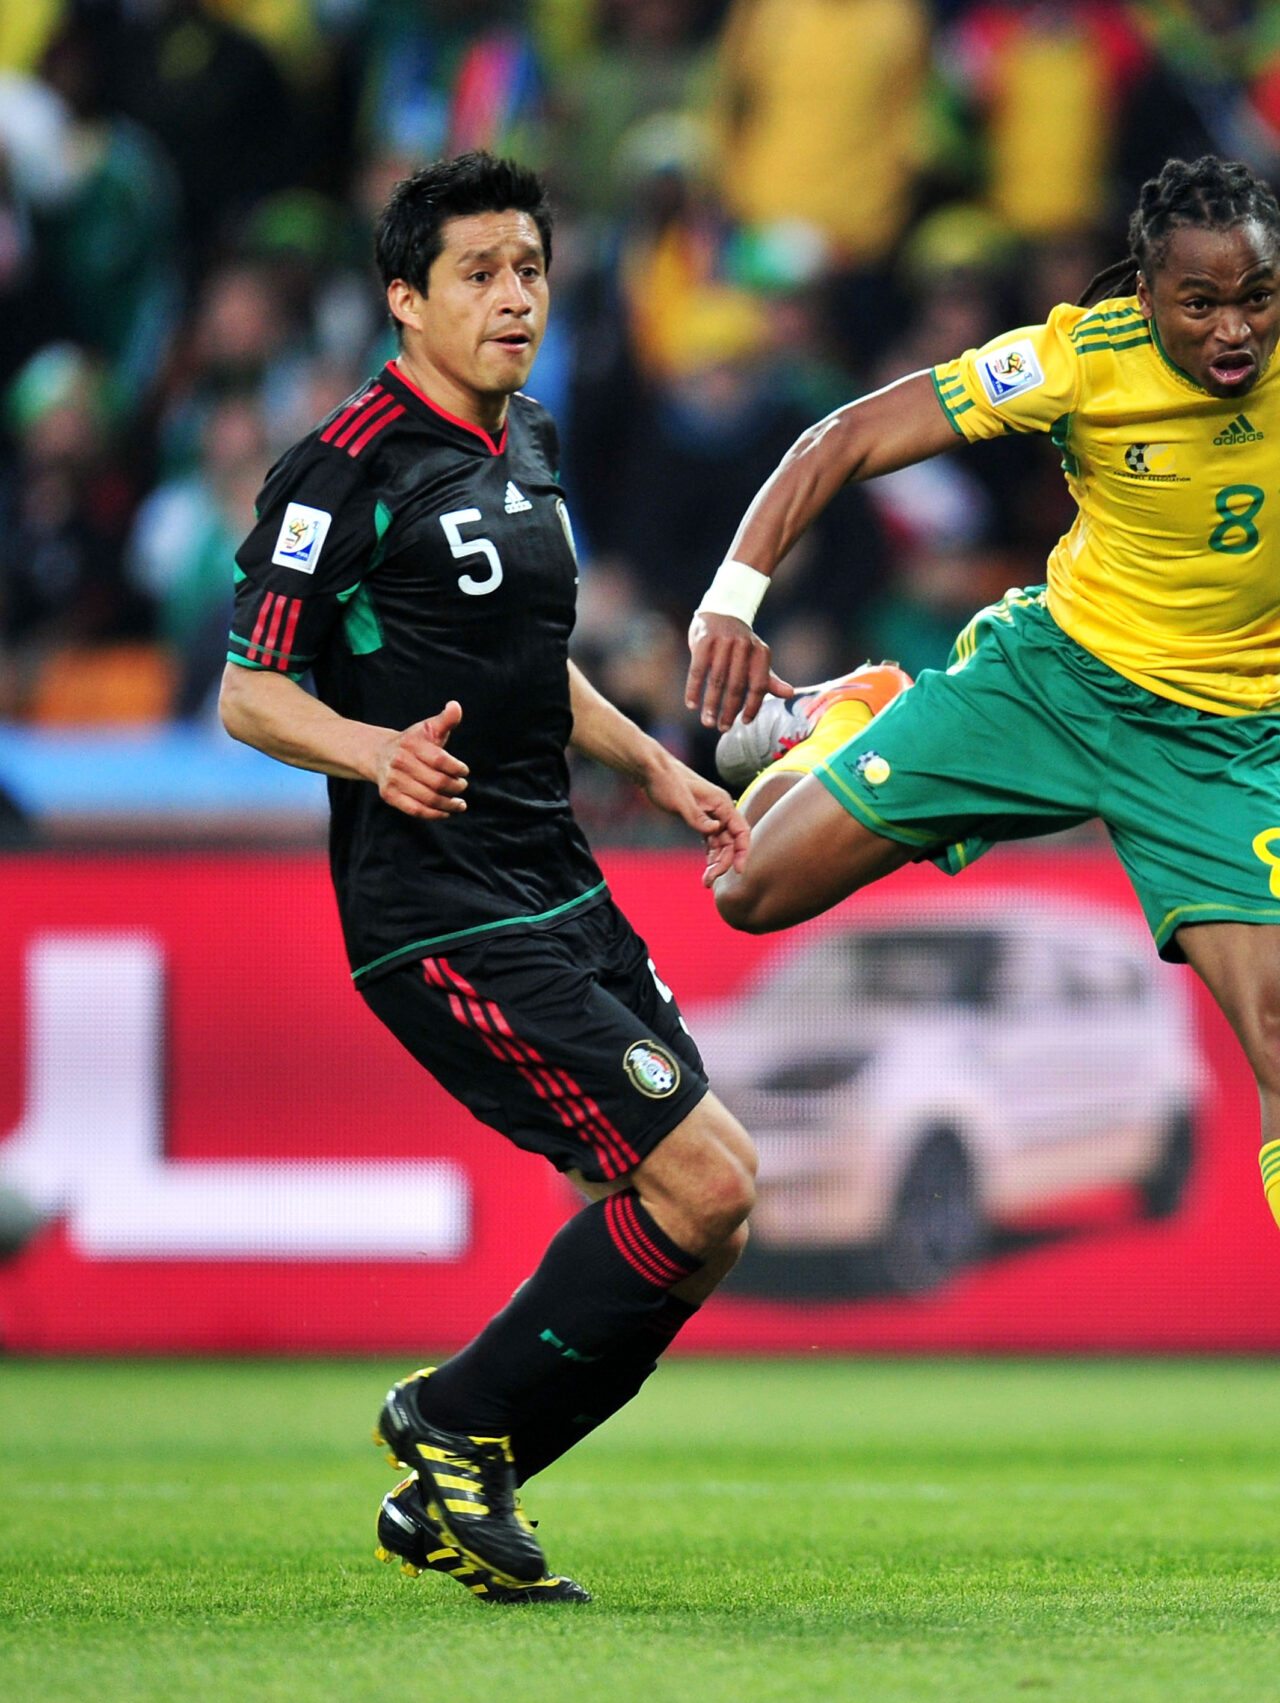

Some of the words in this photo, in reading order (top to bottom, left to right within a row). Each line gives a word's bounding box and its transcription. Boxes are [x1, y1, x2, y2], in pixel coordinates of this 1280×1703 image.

[1212, 431, 1264, 446] adidas
[439, 507, 504, 596] 5
[1208, 483, 1265, 555] 8
